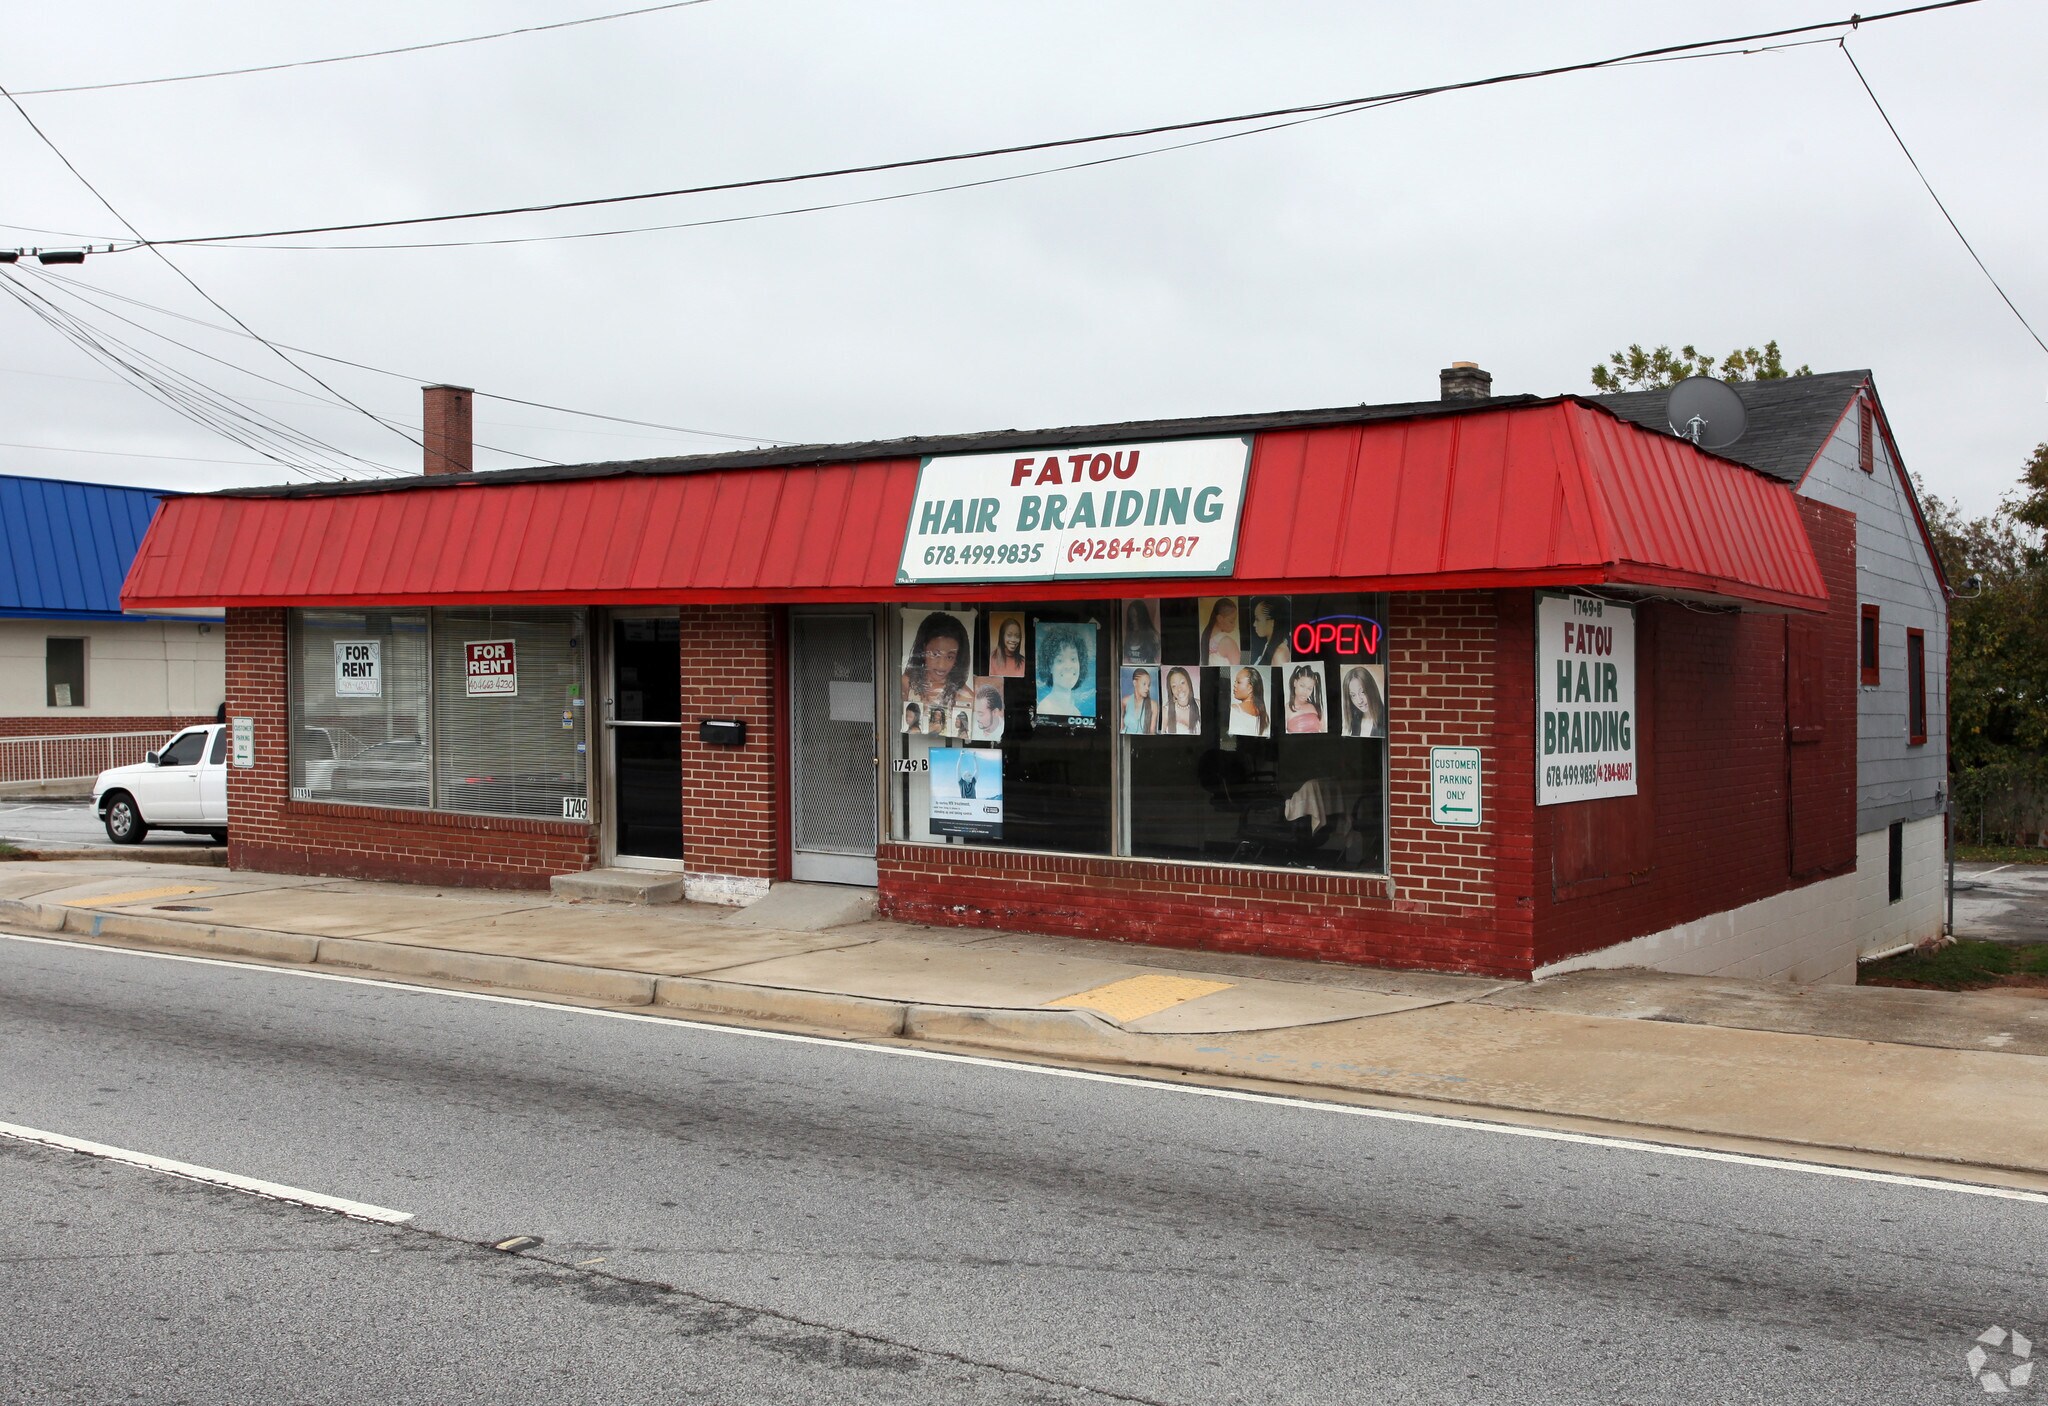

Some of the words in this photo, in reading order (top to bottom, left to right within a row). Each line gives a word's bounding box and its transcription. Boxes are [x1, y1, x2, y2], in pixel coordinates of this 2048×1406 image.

[1010, 451, 1140, 487] FATOU
[918, 498, 1001, 535] HAIR
[1016, 486, 1224, 532] BRAIDING
[923, 543, 1044, 566] 678.499.9835
[1066, 536, 1200, 563] (4)284-8087
[1573, 598, 1603, 618] 1749-B
[1293, 623, 1377, 655] OPEN
[1564, 621, 1613, 656] FATOU
[345, 645, 369, 660] FOR
[473, 645, 506, 659] FOR
[342, 662, 374, 677] RENT
[469, 660, 512, 674] RENT
[1556, 659, 1618, 703] HAIR
[1067, 717, 1096, 726] COOL
[1544, 710, 1631, 755] BRAIDING
[893, 759, 918, 771] 1749
[922, 759, 929, 771] B
[1434, 759, 1477, 769] CUSTOMER
[1439, 775, 1473, 785] PARKING
[1446, 791, 1466, 800] ONLY
[565, 798, 588, 819] 1749
